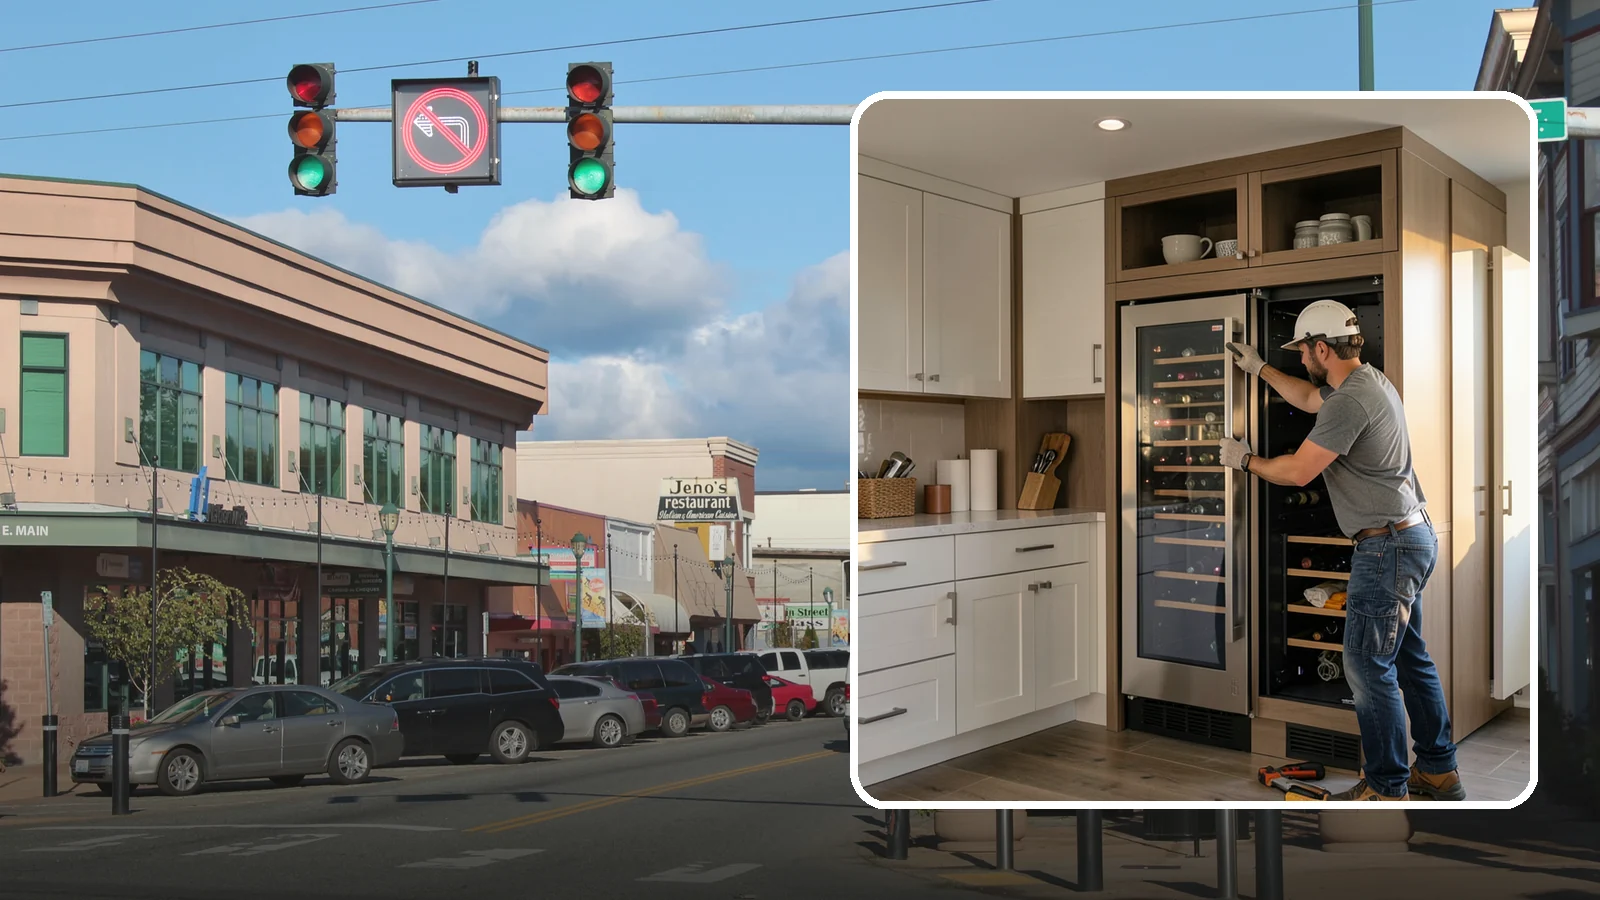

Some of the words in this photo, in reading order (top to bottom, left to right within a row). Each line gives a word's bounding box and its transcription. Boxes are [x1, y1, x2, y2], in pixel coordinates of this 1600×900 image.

[670, 480, 728, 494] Jeno's
[665, 496, 731, 509] restaurant
[659, 509, 681, 519] Italian
[685, 509, 715, 519] American
[715, 509, 737, 519] Cuisine
[2, 525, 13, 536] E.
[15, 525, 49, 536] MAIN
[797, 607, 828, 616] Street
[791, 619, 823, 627] lass
